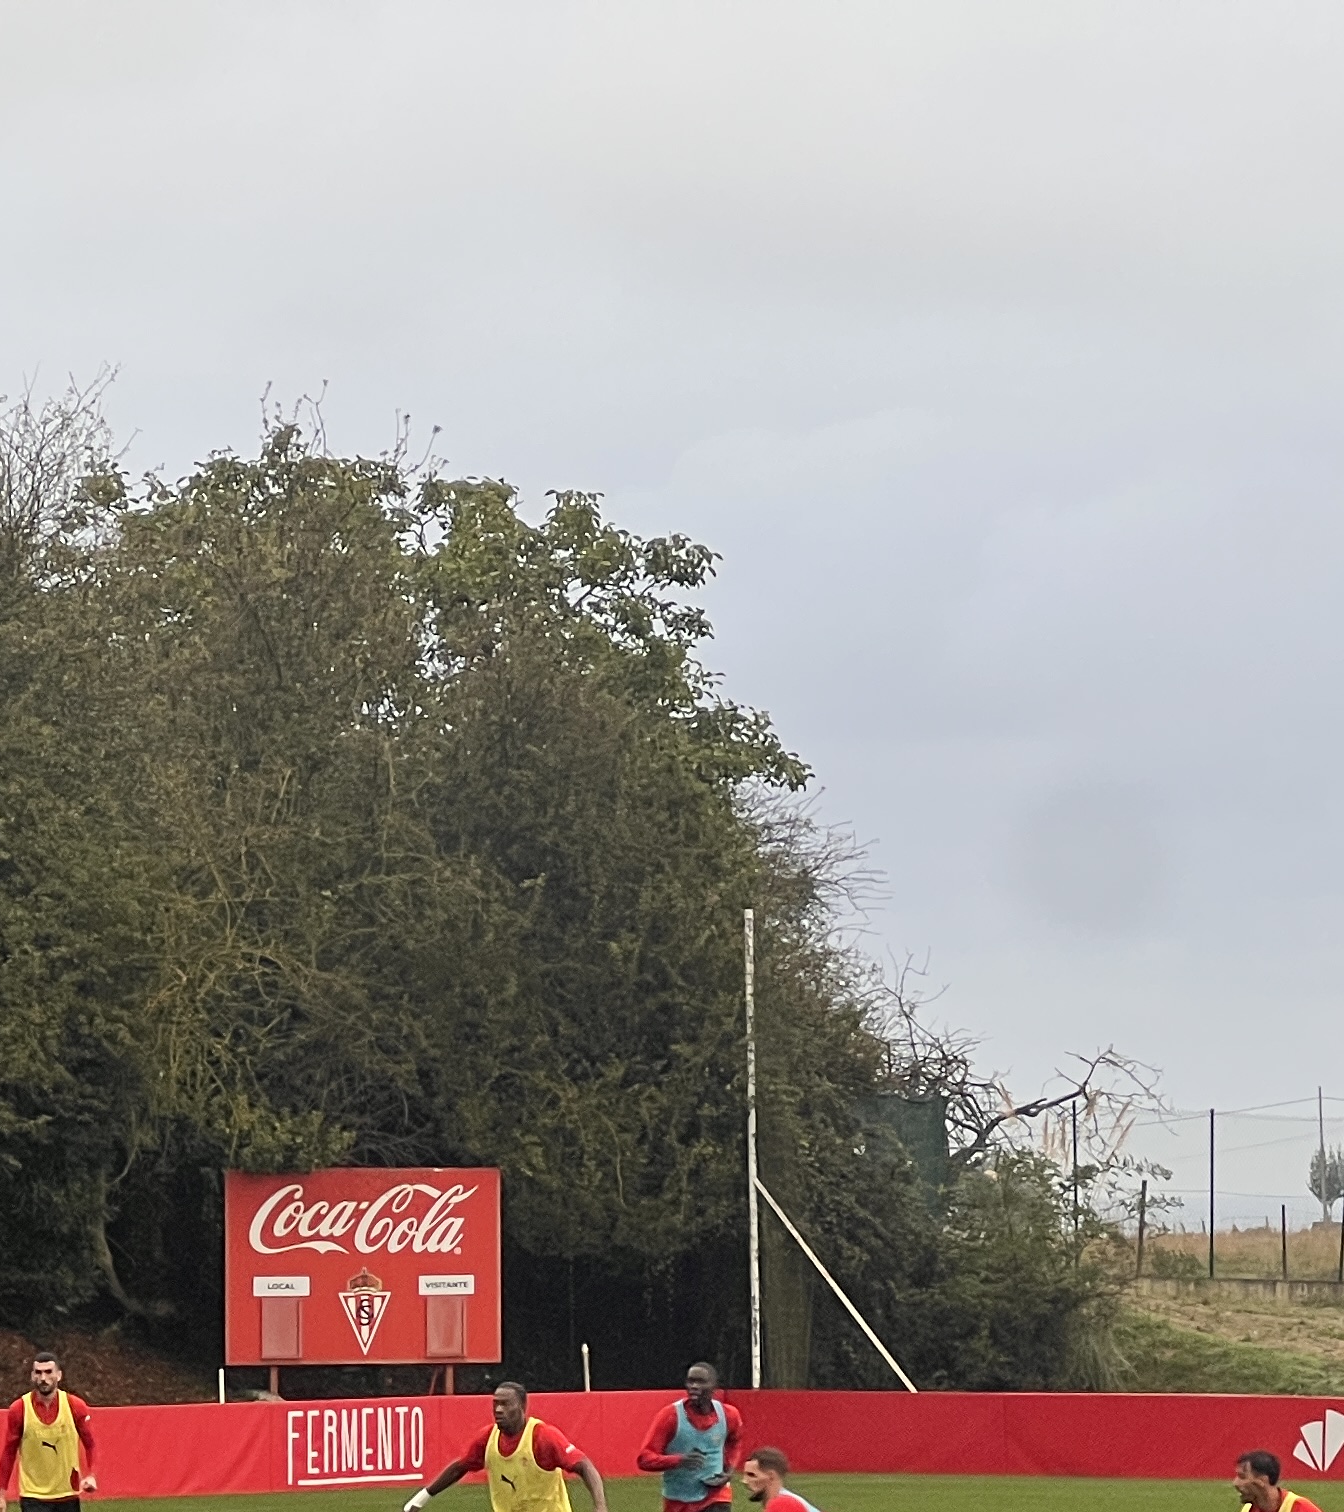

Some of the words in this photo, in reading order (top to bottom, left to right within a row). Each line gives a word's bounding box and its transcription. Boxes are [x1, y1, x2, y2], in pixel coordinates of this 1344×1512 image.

[267, 1282, 295, 1290] LOCAL
[425, 1281, 468, 1289] VISITANTE
[287, 1406, 424, 1485] FERMENTO
